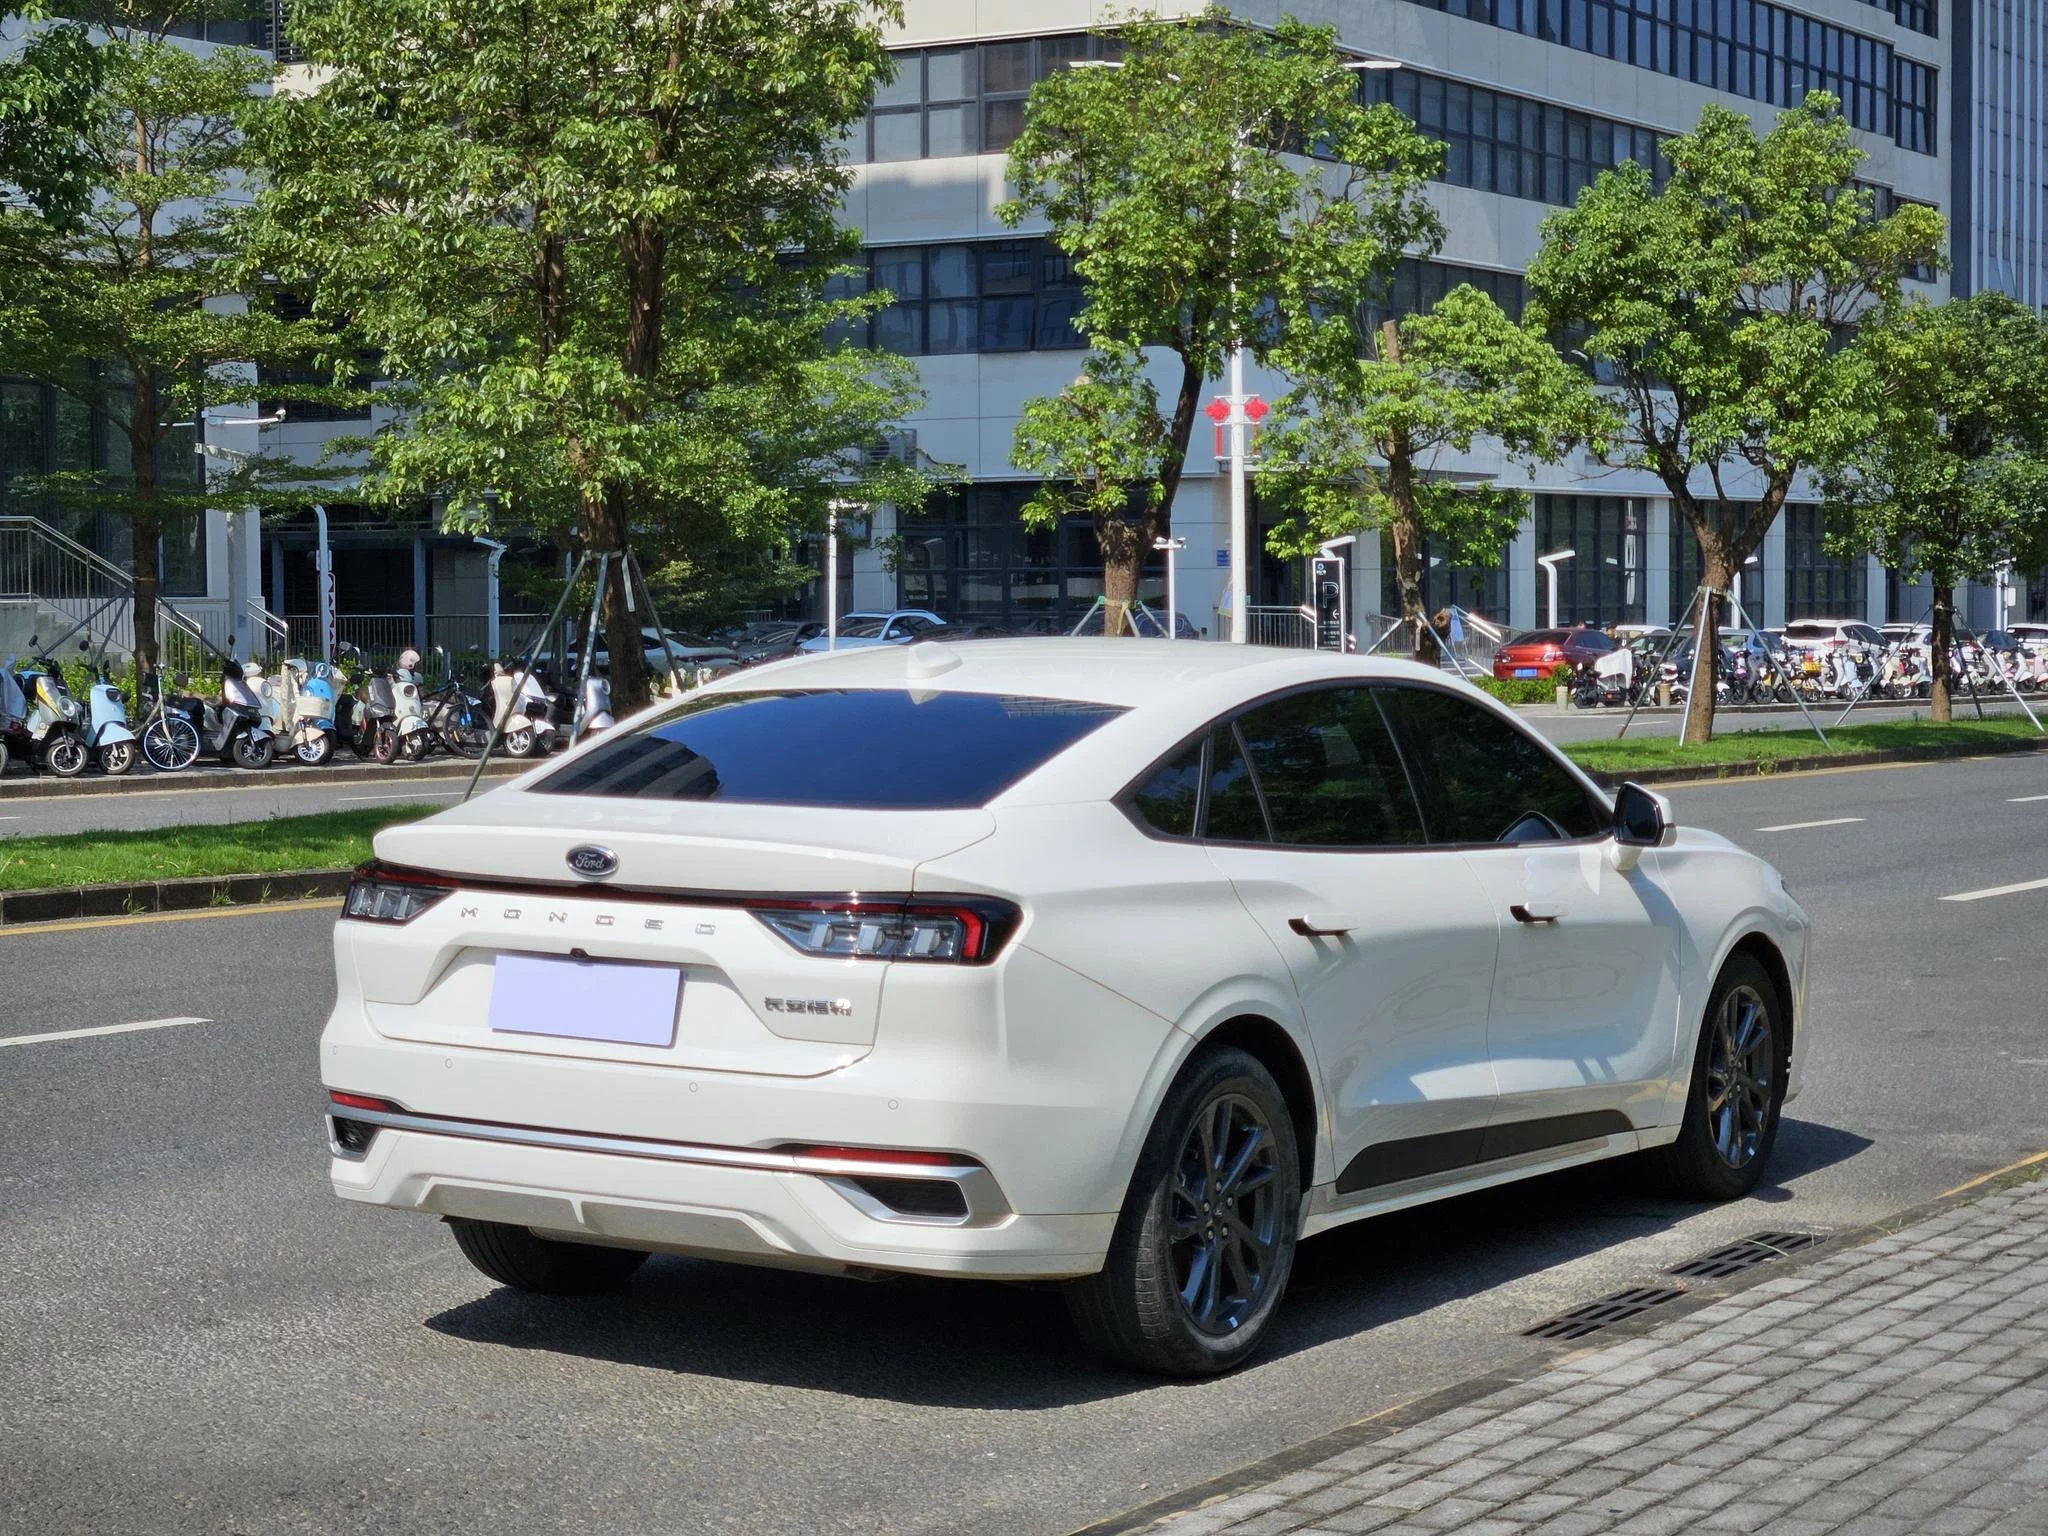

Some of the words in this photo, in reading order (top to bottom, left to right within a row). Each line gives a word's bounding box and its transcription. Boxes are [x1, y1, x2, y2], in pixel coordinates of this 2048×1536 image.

[1322, 581, 1340, 609] P
[575, 851, 605, 869] Ford
[460, 906, 716, 936] MONDEO
